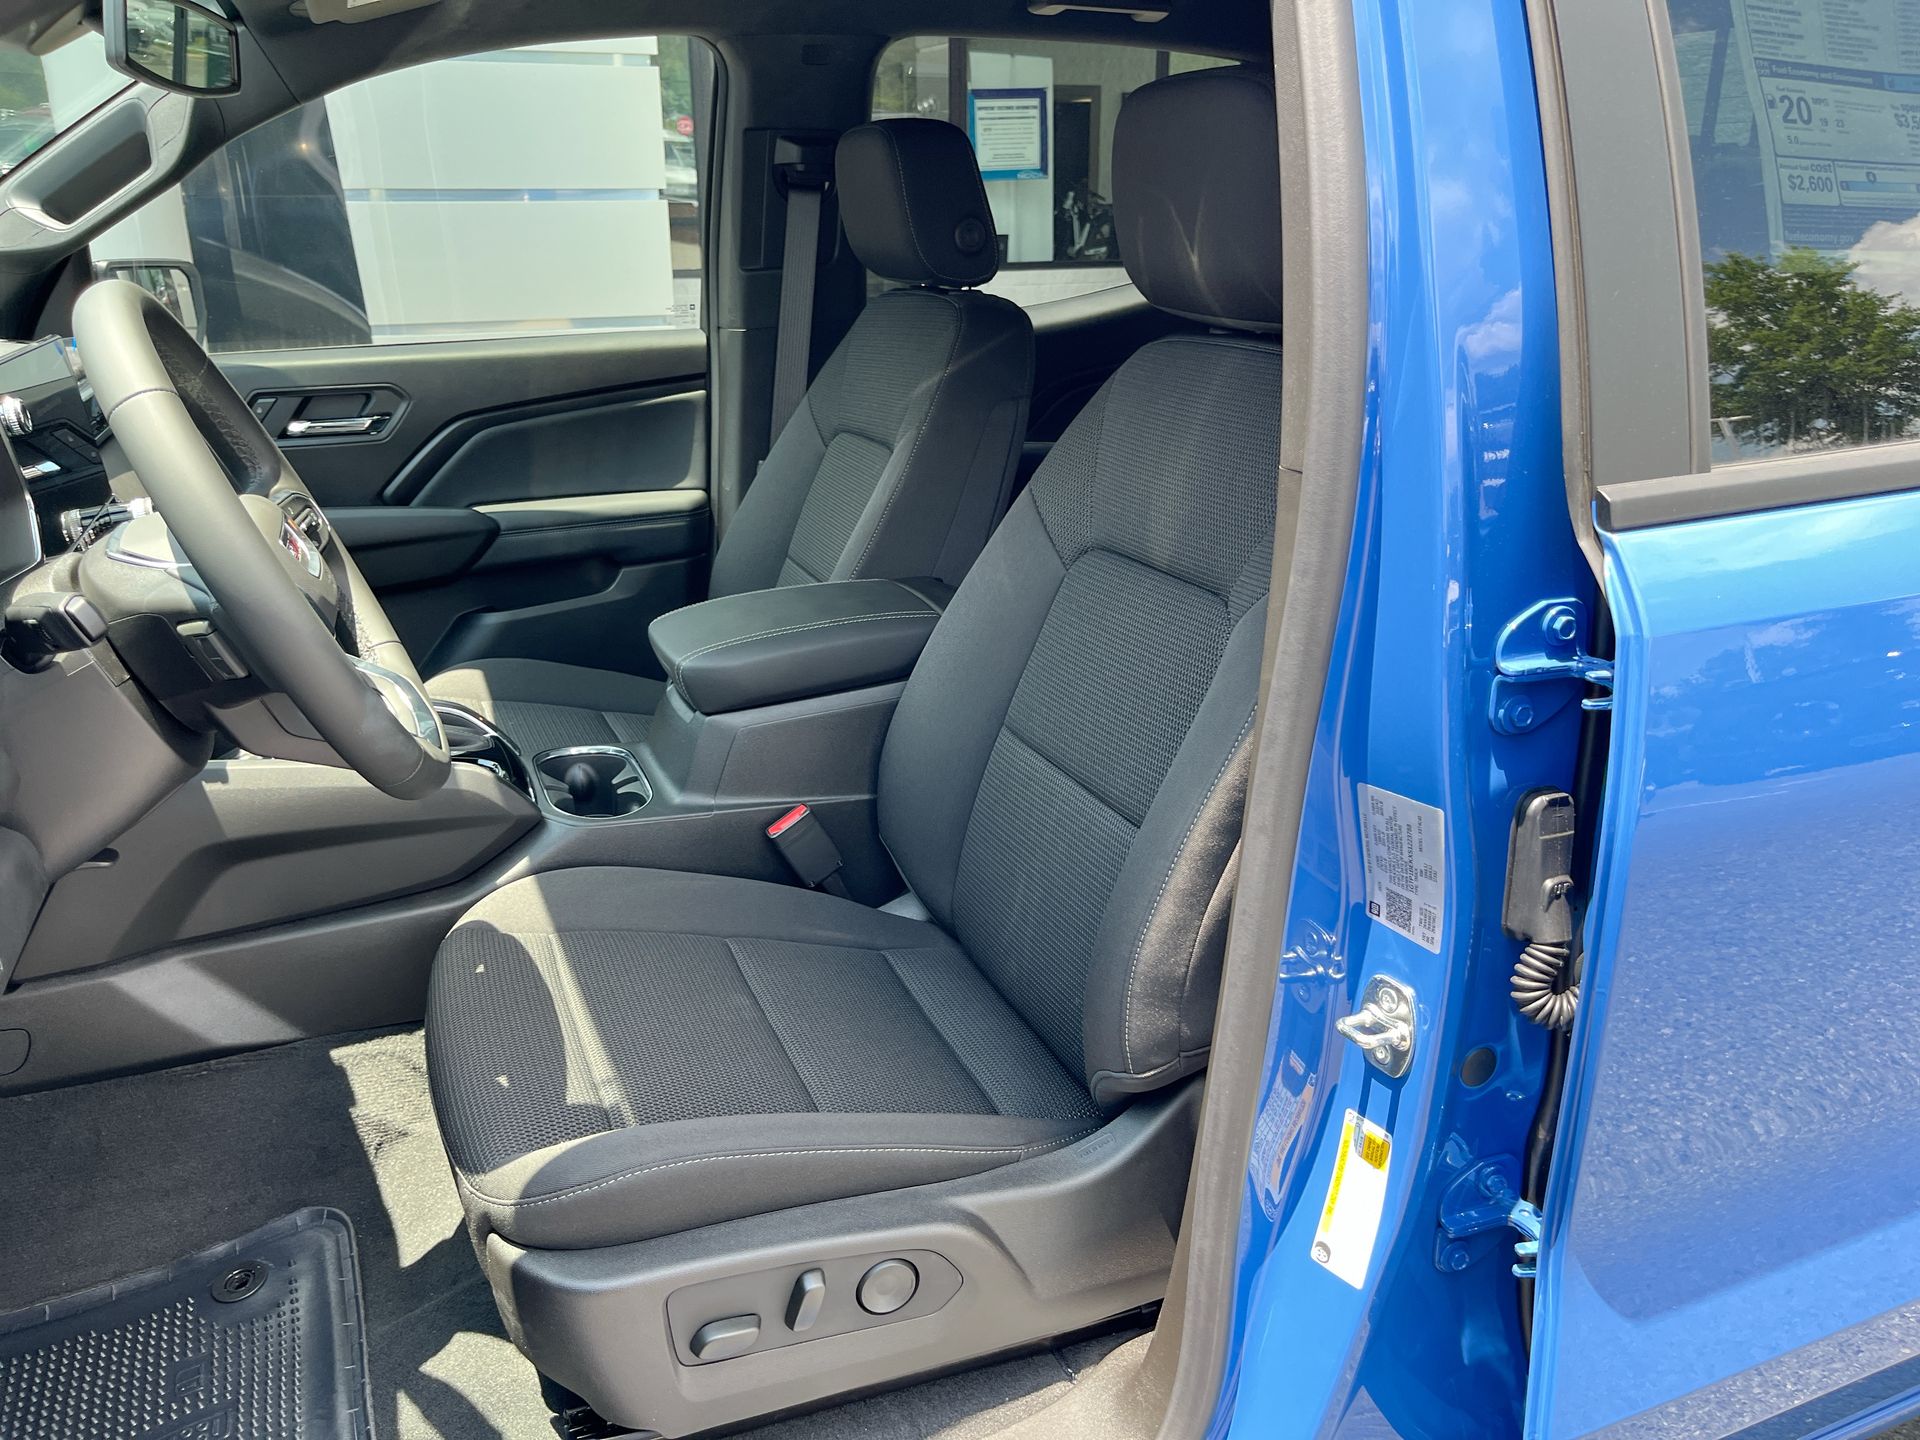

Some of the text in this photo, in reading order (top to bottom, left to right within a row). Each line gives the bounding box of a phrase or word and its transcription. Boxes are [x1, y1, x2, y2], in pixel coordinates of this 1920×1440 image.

[1778, 94, 1813, 126] 20
[1810, 162, 1833, 174] cost
[1787, 174, 1834, 193] $2,600
